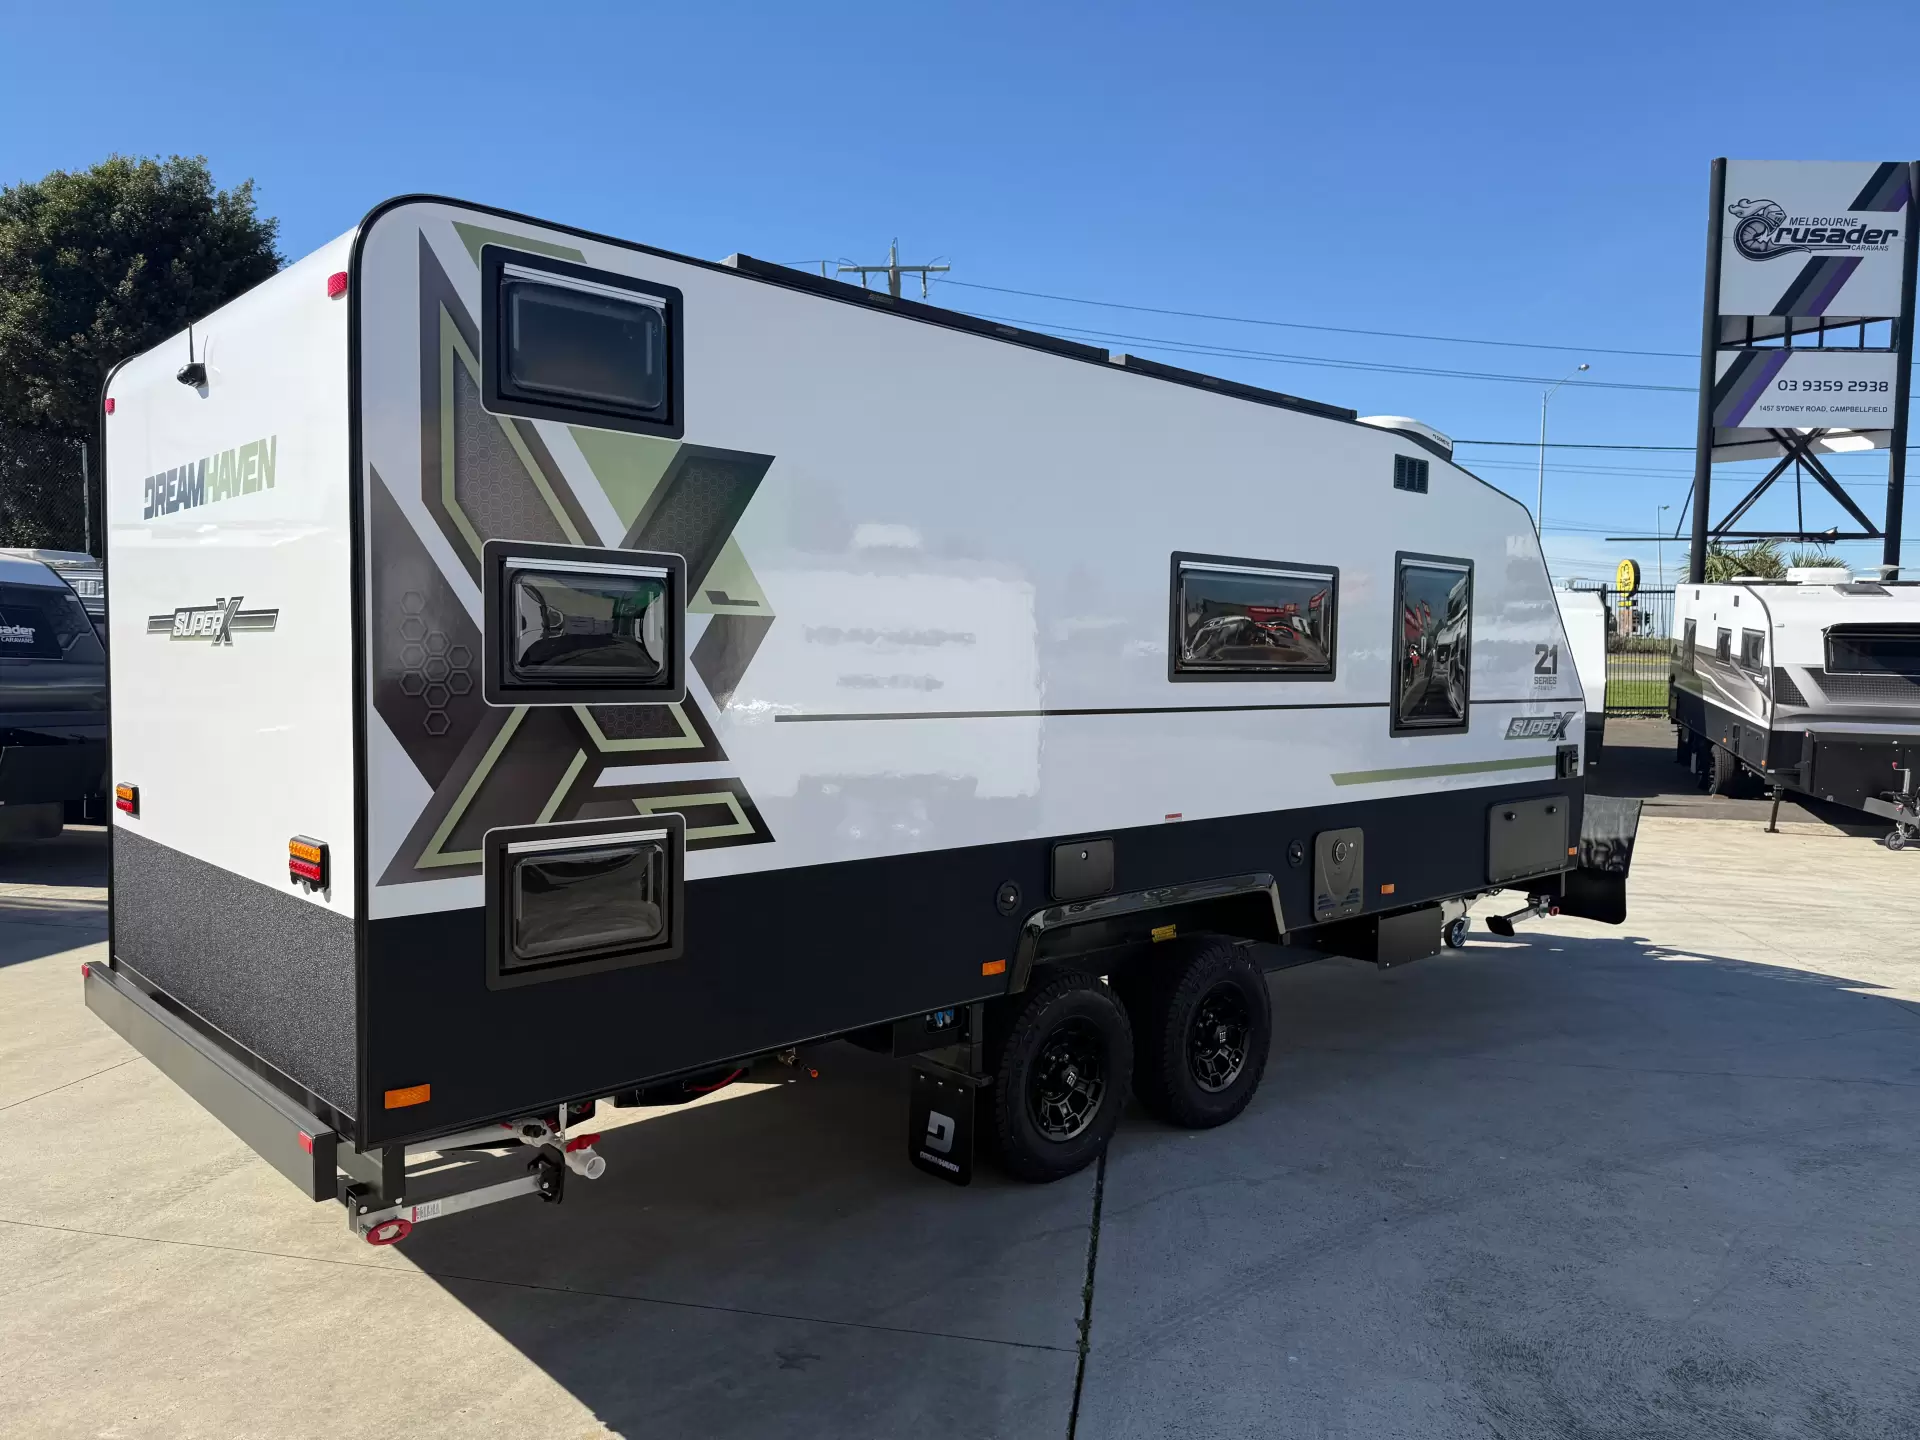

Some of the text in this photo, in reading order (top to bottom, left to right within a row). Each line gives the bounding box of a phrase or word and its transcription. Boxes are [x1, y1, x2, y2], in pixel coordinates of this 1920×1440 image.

[1789, 217, 1858, 227] MELBOURNE
[1851, 244, 1889, 252] CARAVANS
[1777, 379, 1889, 393] 03 9359 2938
[1775, 405, 1805, 413] SYDNEY
[1829, 406, 1888, 414] CAMPBELLFIELD
[1534, 643, 1558, 675] 21
[1533, 676, 1557, 685] SERIES
